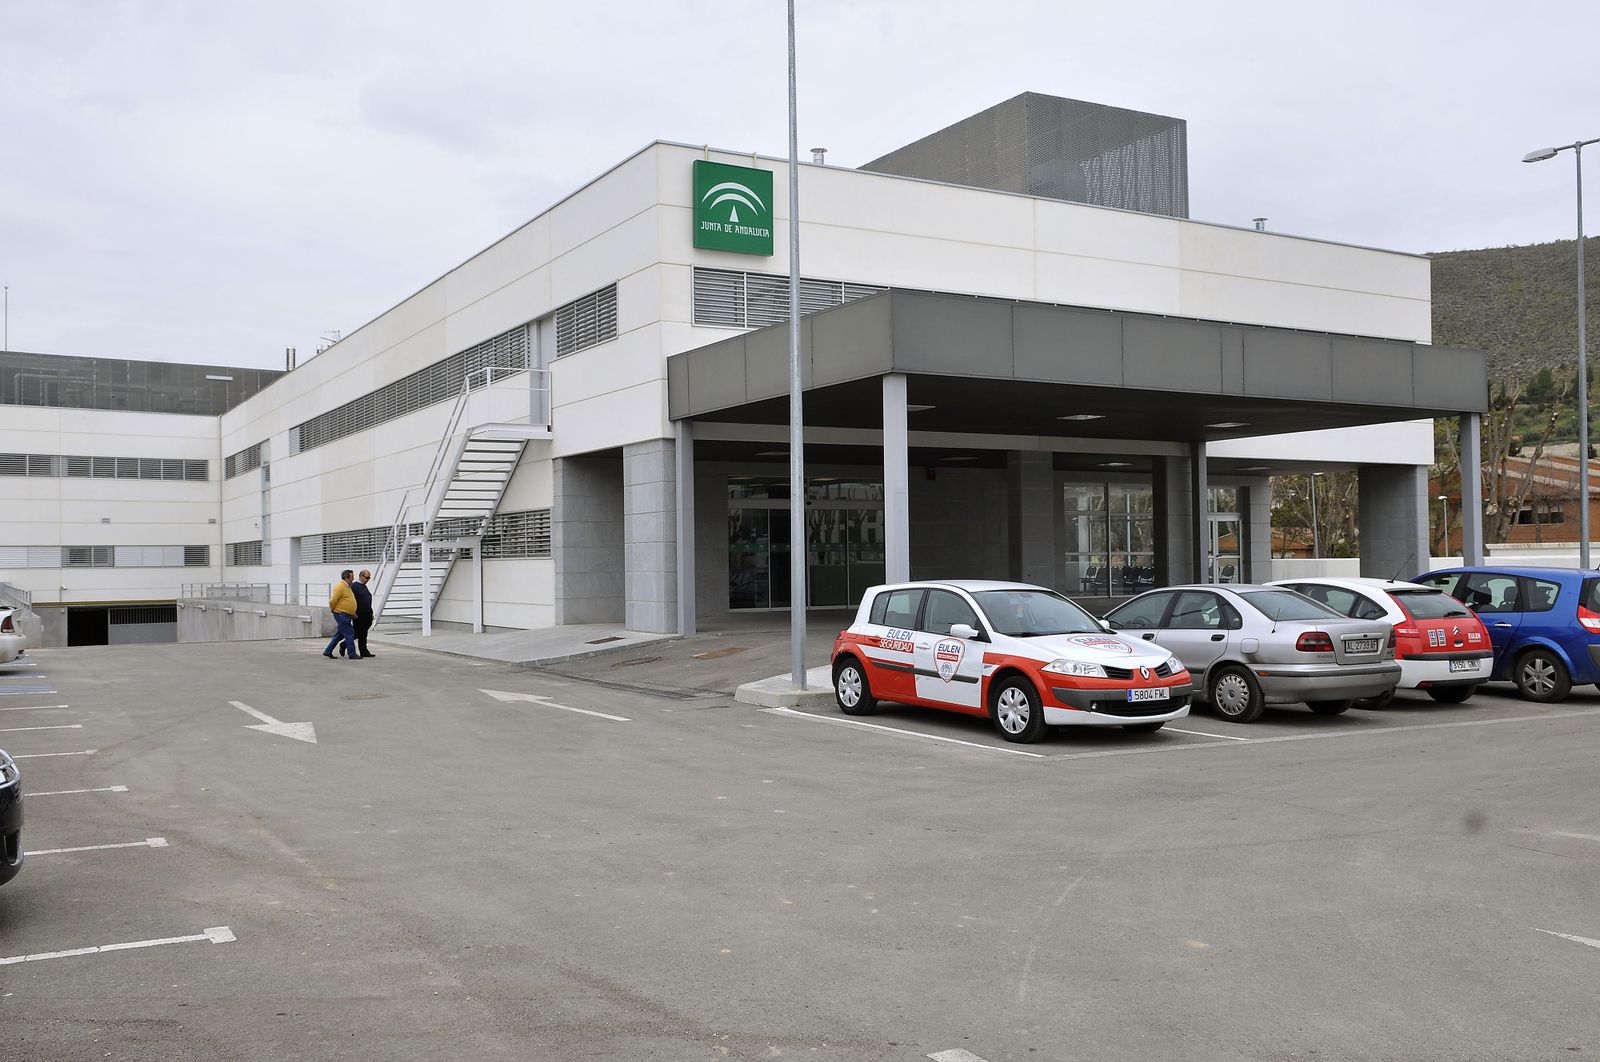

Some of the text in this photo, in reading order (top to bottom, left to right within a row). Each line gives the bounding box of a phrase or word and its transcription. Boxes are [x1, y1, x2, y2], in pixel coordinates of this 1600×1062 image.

[701, 221, 769, 238] JUNTA DE ANDALUCIA
[886, 628, 913, 641] EULEN
[879, 638, 913, 652] SEGURIDAD
[938, 643, 961, 653] EULEN
[1134, 690, 1153, 700] 5804
